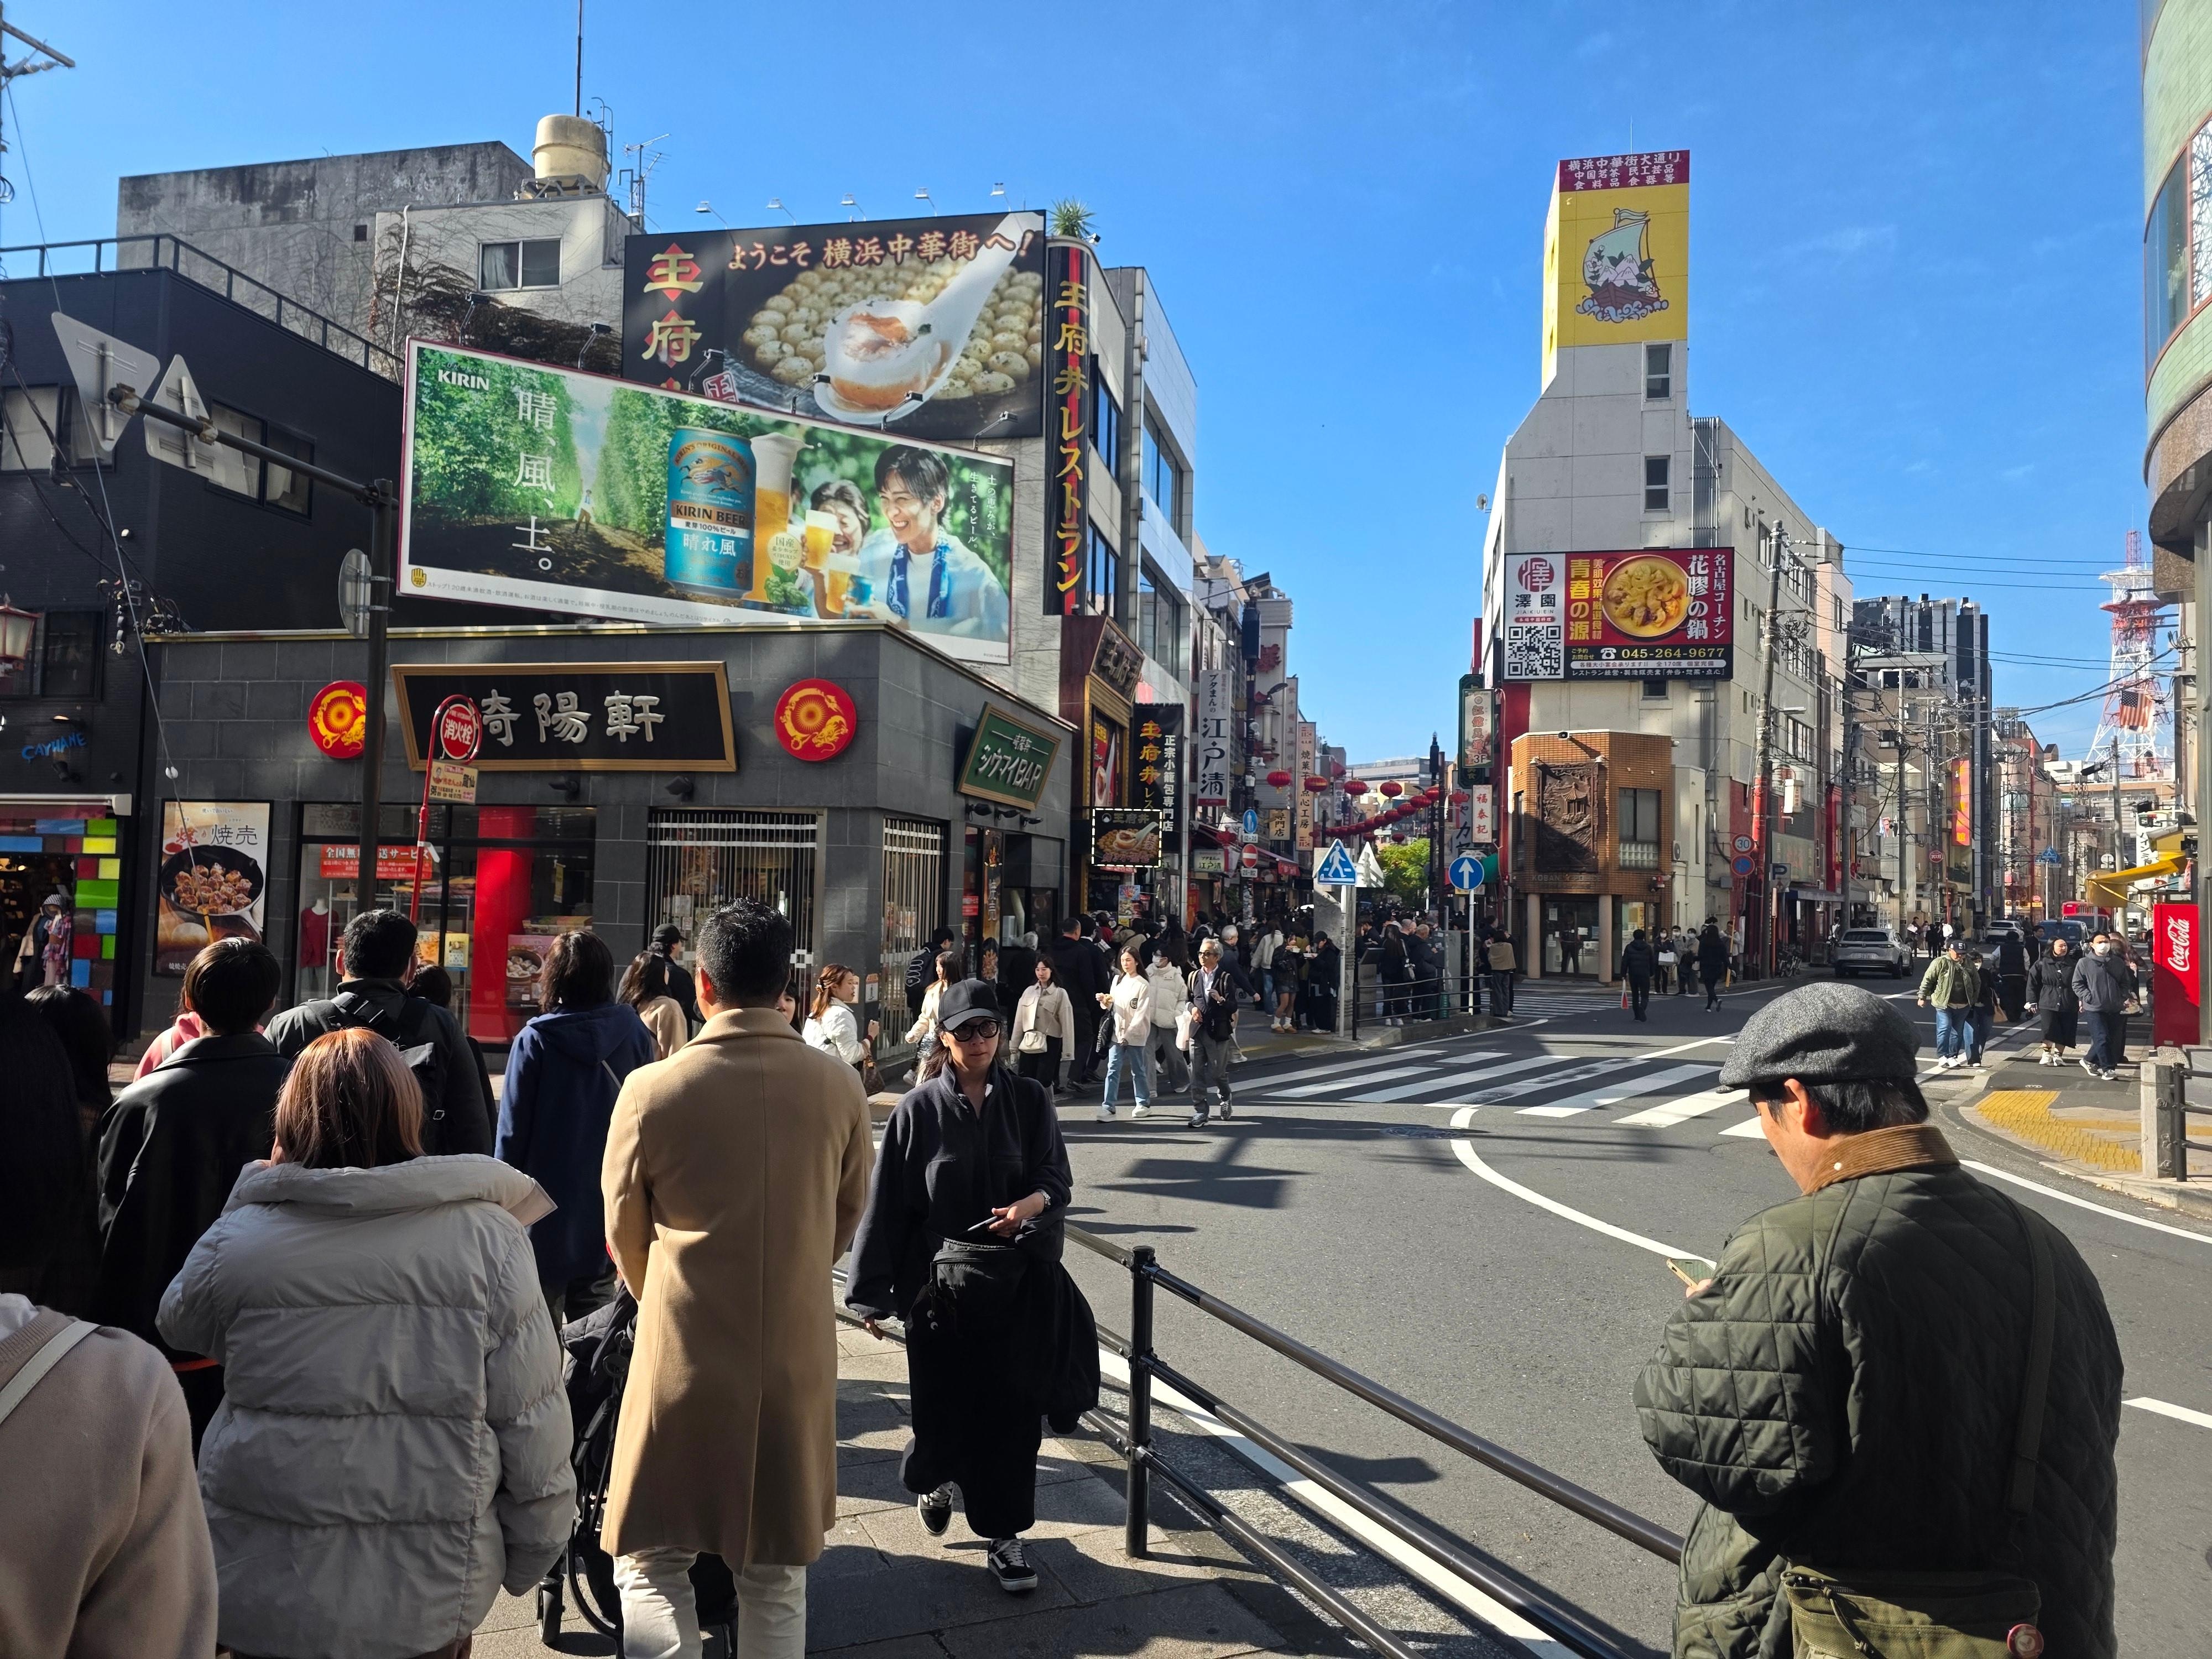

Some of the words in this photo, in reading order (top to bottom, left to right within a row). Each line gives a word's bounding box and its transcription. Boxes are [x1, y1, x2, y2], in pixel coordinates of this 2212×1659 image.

[1568, 152, 1681, 171] 横浜中華街大通り
[1573, 178, 1620, 190] 食料品
[1627, 174, 1675, 186] 食器等
[728, 241, 812, 270] ようこそ
[643, 252, 704, 391] 王府
[438, 369, 489, 391] KIRIN
[1052, 280, 1090, 593] 王府井レストラン
[676, 504, 713, 520] KIRIN
[716, 510, 747, 526] BEER
[683, 532, 737, 557] 晴れ風
[1569, 559, 1590, 640] 青春の源
[1686, 554, 1710, 640] 花膠の鍋
[1713, 554, 1727, 640] 名古屋コーチン
[1621, 648, 1725, 659] 045-264-9677
[444, 718, 473, 745] 消火栓
[978, 744, 1042, 792] シウマイBAR
[1199, 717, 1228, 796] 江戸清
[1473, 754, 1488, 764] 3F
[1162, 734, 1176, 832] 正宗小籠包専門店
[1300, 750, 1311, 829] 焼菓子点心工房
[1476, 793, 1489, 834] 福泰記
[210, 824, 258, 845] 焼売
[1737, 839, 1750, 849] 30
[1772, 865, 1788, 880] P
